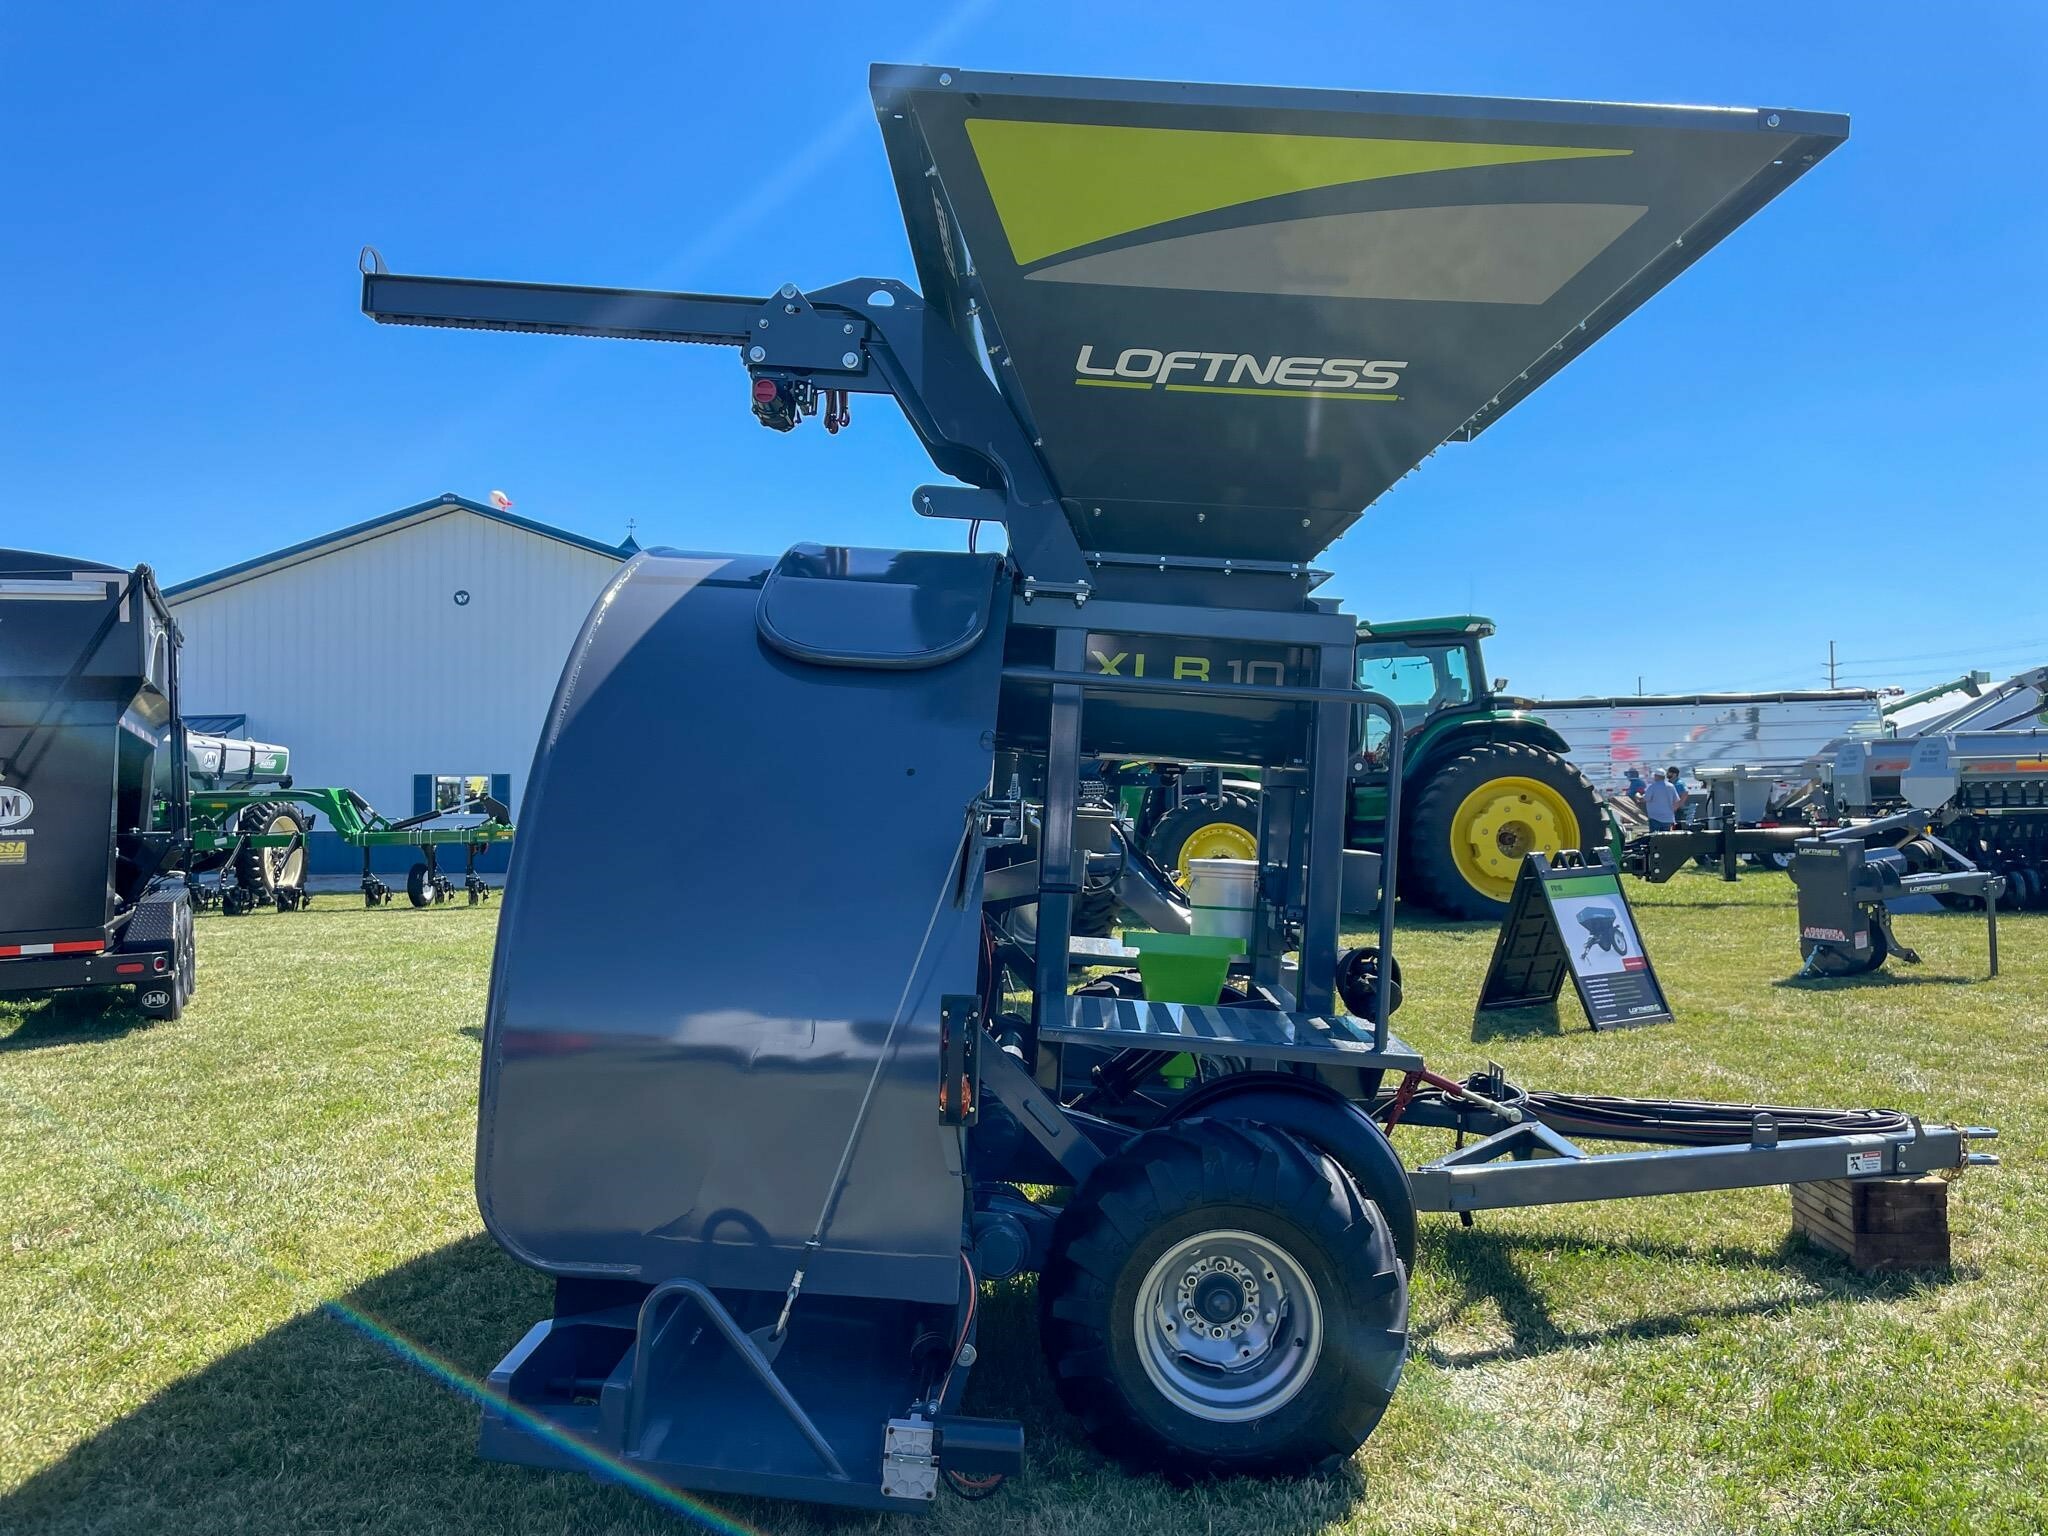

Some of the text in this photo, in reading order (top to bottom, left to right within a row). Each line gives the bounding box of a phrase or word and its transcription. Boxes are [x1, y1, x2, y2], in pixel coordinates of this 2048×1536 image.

[1075, 345, 1408, 389] LOFTNESS
[1799, 848, 1832, 857] LOFTNESS
[1909, 884, 1942, 894] LOFTNESS
[144, 993, 166, 1005] J&M
